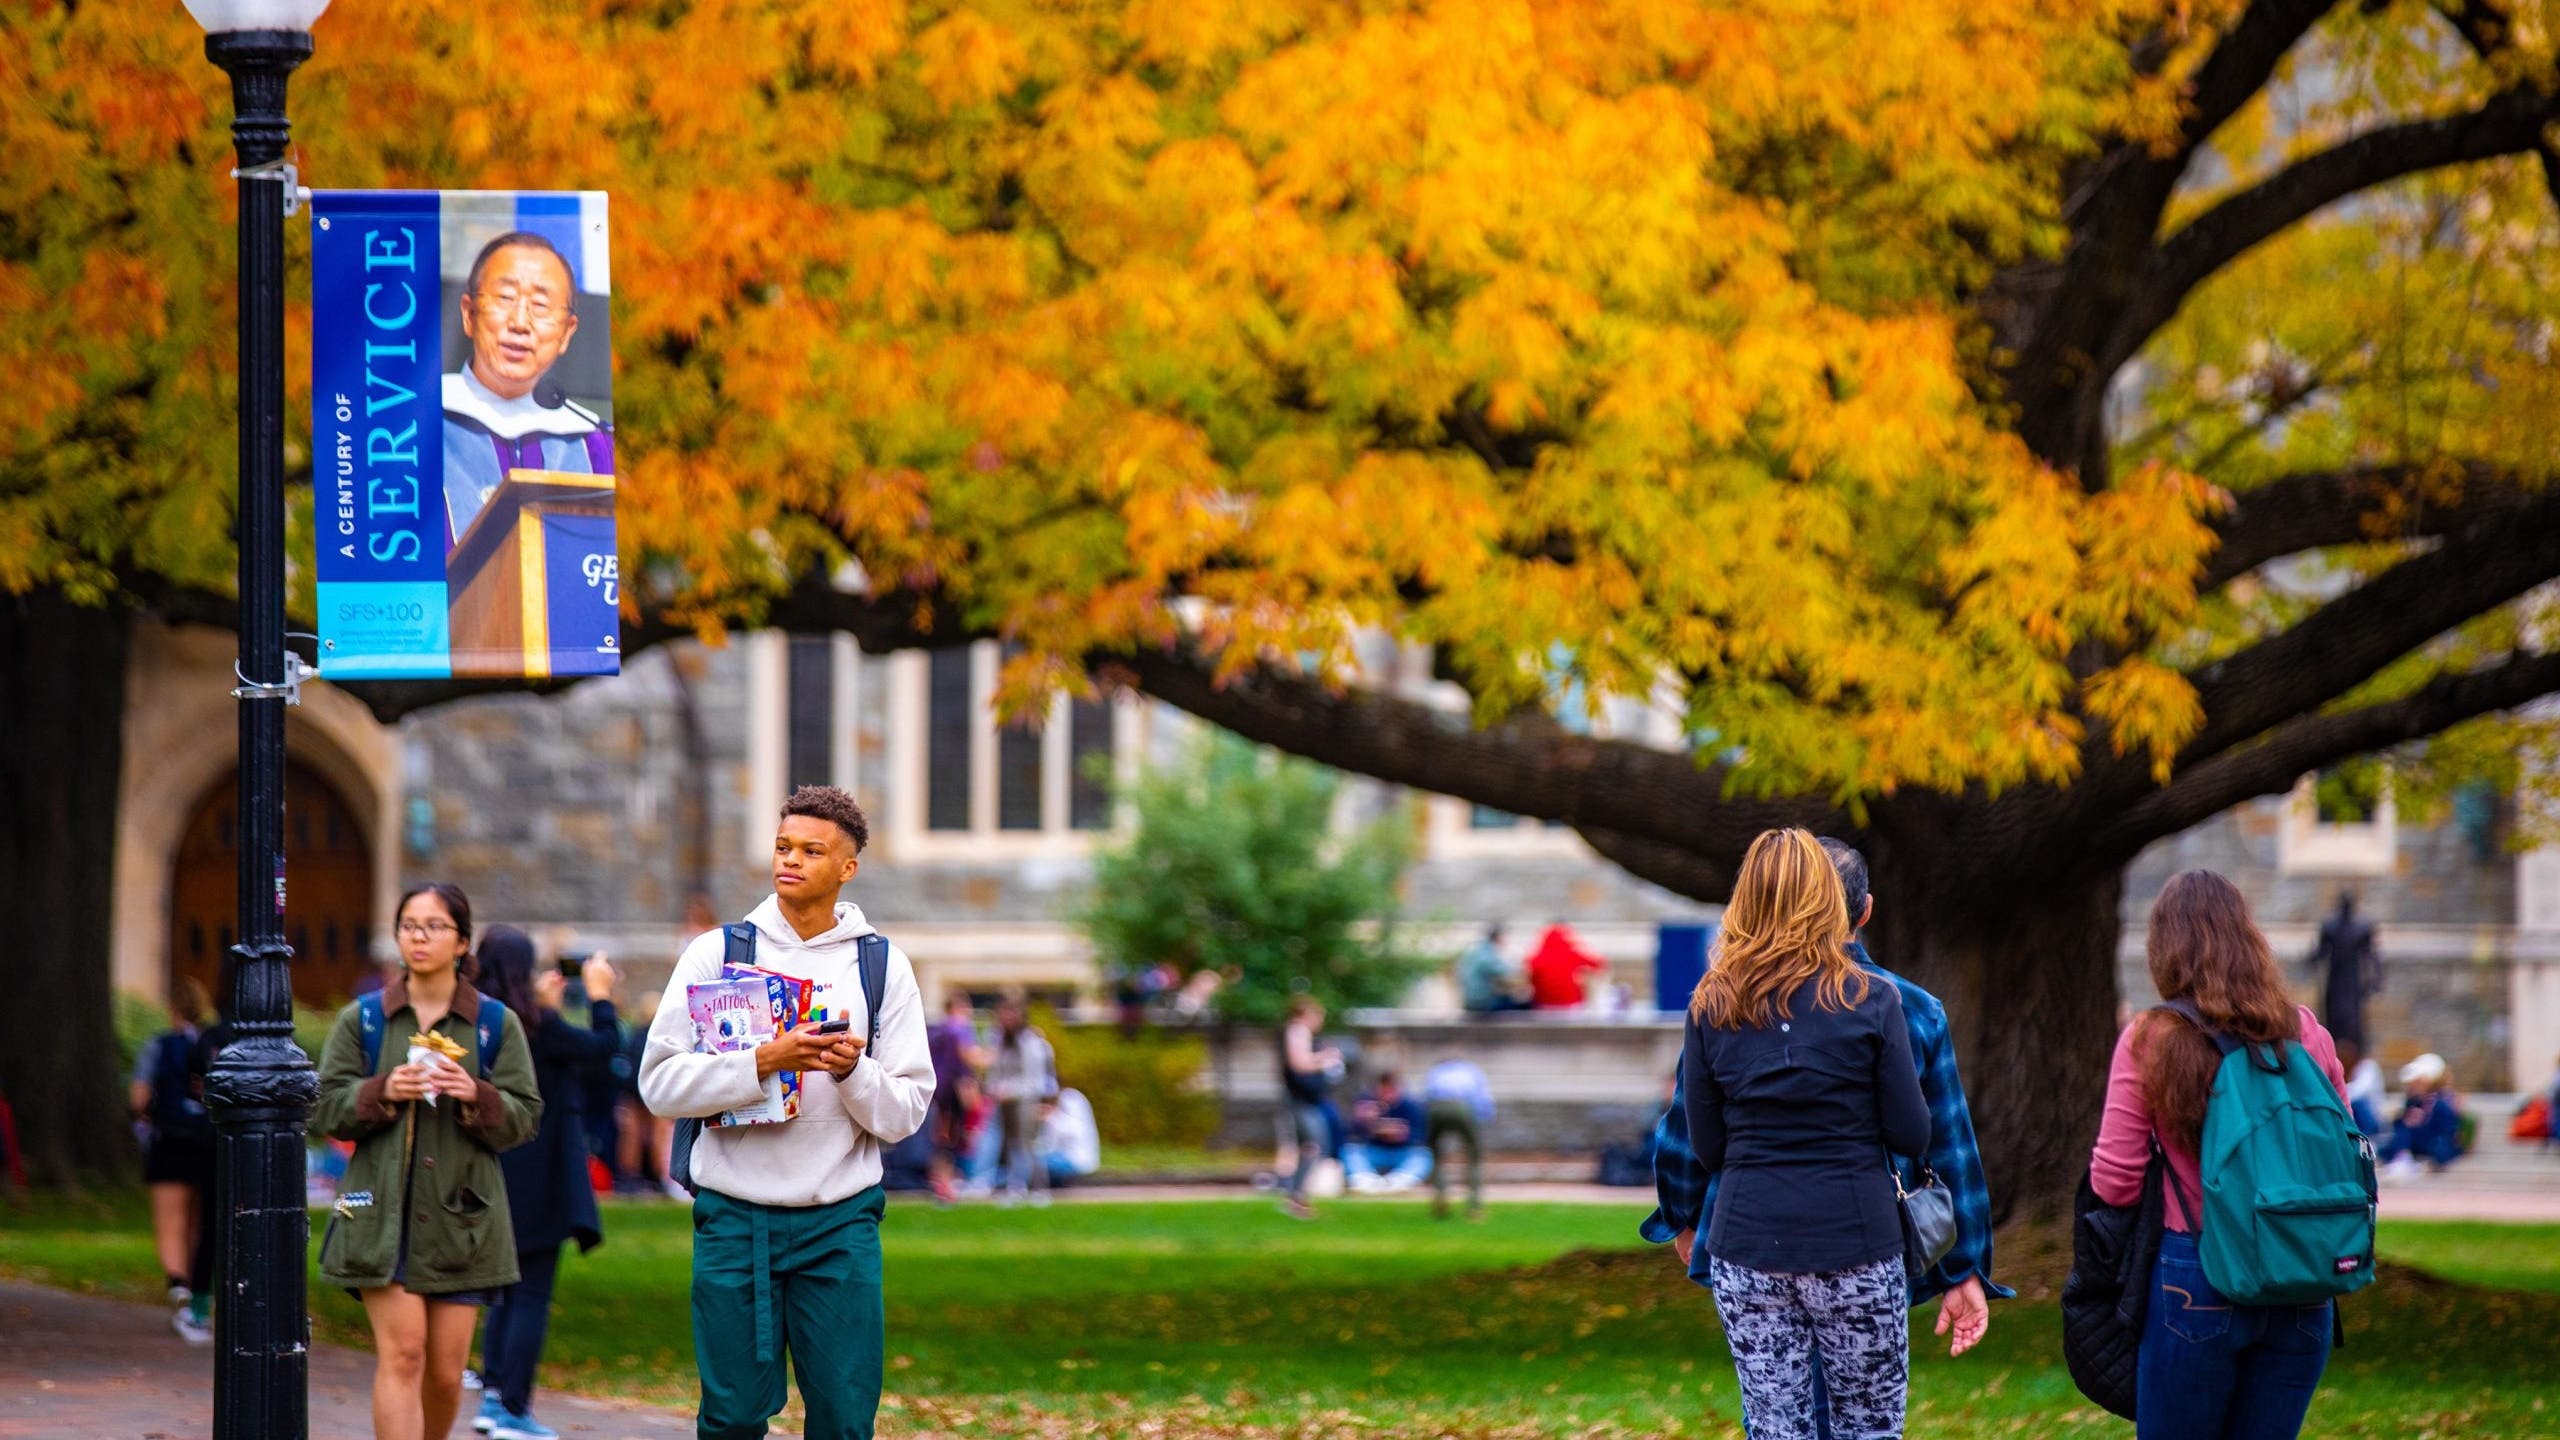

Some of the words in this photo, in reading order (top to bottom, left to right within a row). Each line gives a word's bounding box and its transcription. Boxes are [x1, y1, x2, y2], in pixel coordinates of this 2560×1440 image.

[335, 391, 352, 422] OF
[364, 226, 421, 562] SERVICE
[336, 430, 355, 535] CENTURY
[339, 543, 356, 559] A
[712, 994, 752, 1013] TATTOOS
